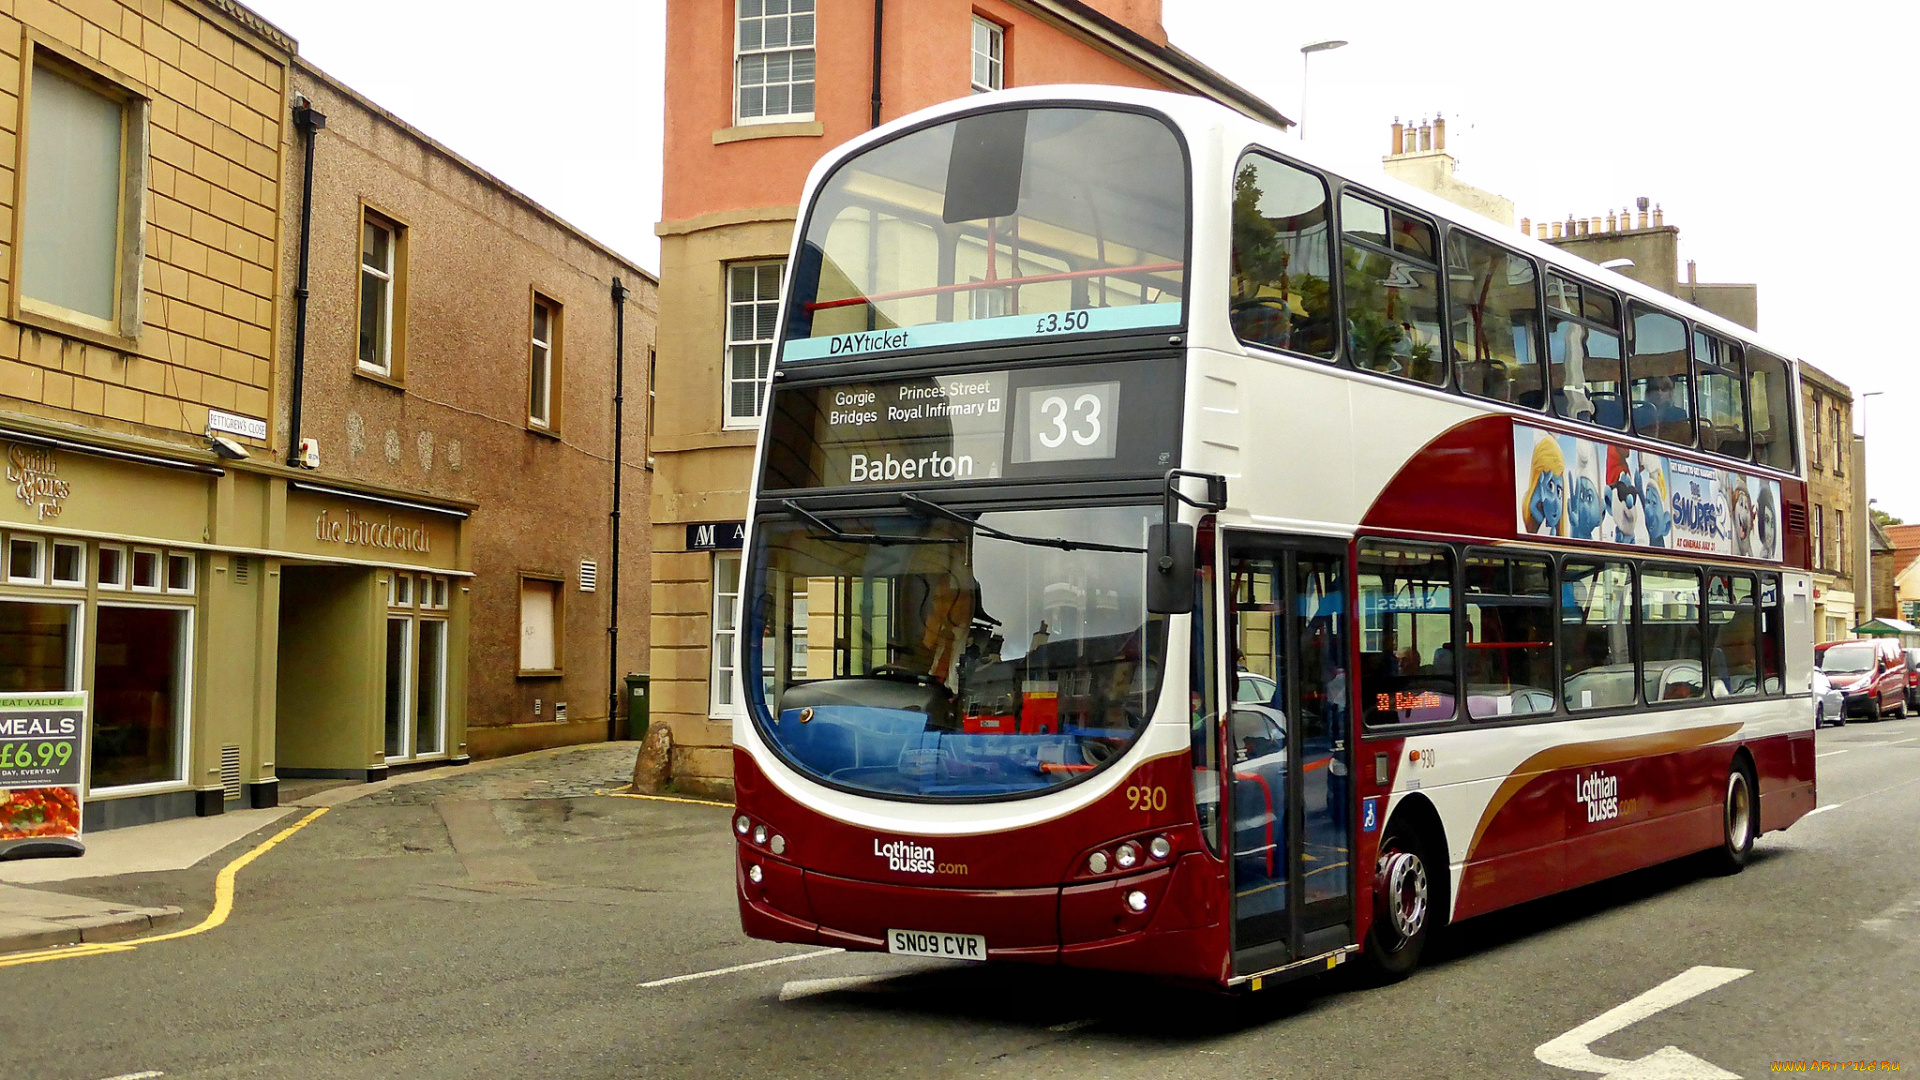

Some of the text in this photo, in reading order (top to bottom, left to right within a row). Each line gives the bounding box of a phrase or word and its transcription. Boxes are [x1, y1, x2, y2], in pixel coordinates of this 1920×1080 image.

[830, 310, 1089, 355] DAYticket £3.50
[835, 390, 876, 407] Gorgie
[899, 379, 991, 401] Princes Street
[830, 410, 878, 426] Bridges
[888, 403, 923, 422] Royal
[925, 401, 985, 418] Infirmary
[1039, 393, 1101, 448] 33
[248, 421, 266, 436] CLOSE
[850, 450, 974, 482] Baberton
[1672, 491, 1717, 535] SMURFS
[316, 508, 342, 542] the
[0, 698, 64, 707] EAT VALUE
[0, 718, 76, 735] MEALS
[0, 741, 73, 768] £6.99
[1420, 748, 1435, 769] 930
[1126, 785, 1167, 811] 930
[1576, 769, 1619, 804] Lothian
[873, 838, 935, 861] Lothian
[895, 932, 978, 956] SN09 CVR
